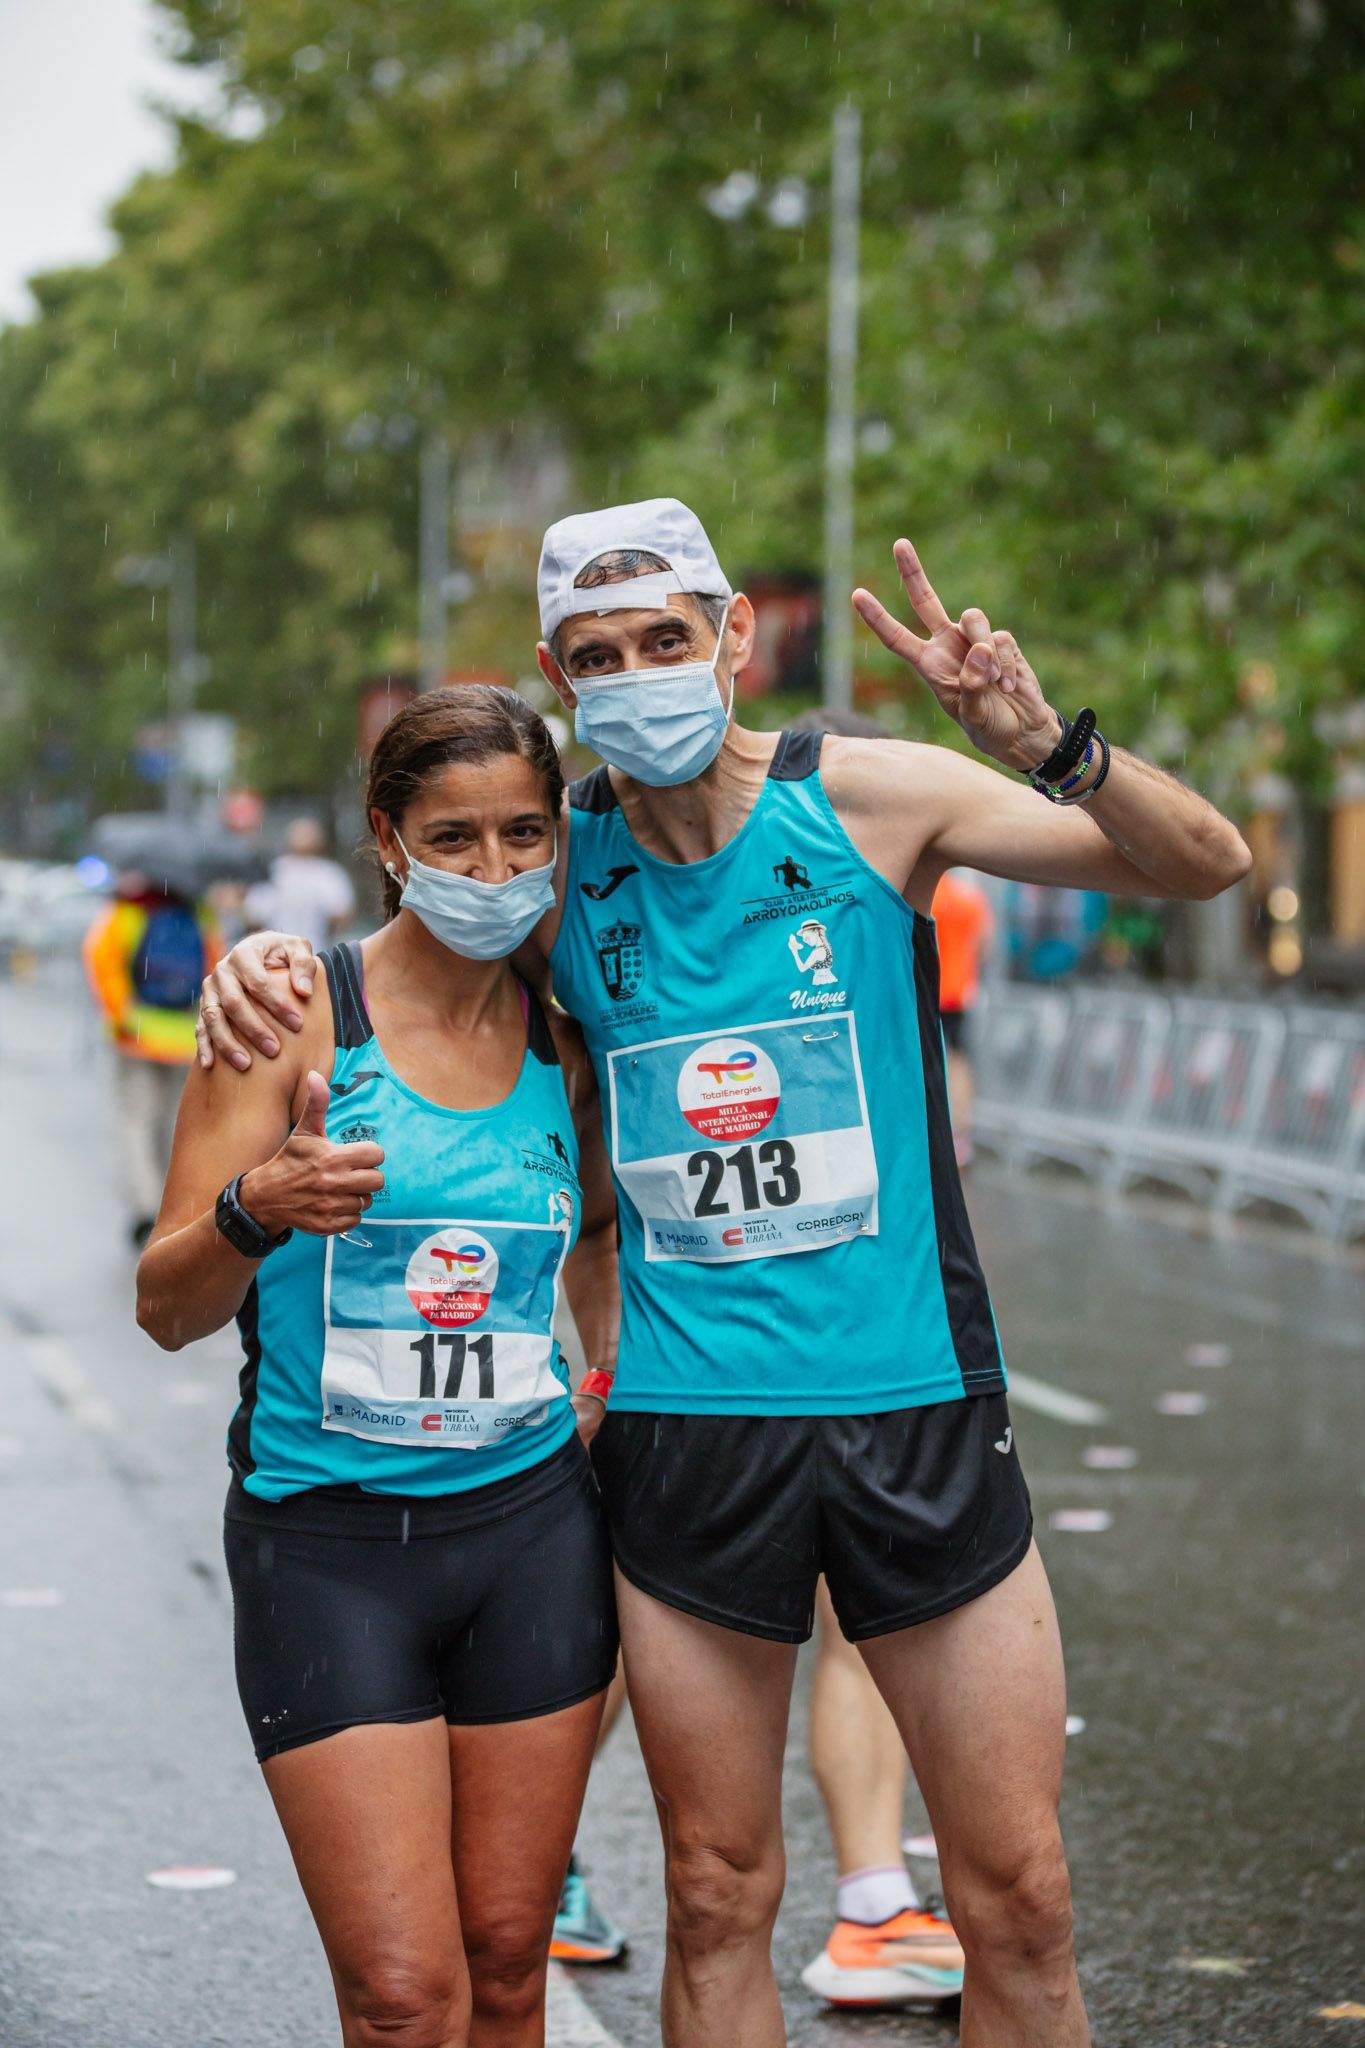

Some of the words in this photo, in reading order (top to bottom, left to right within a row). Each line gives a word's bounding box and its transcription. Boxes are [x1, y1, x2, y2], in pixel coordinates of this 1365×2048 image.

[764, 900, 784, 908] CLUB
[788, 890, 829, 904] ATLETISMO
[743, 890, 856, 925] ARROYOMOLINOS
[789, 990, 847, 1010] Unique
[701, 1086, 762, 1100] TotalEnergies
[718, 1105, 748, 1116] MILLA
[710, 1127, 724, 1136] DE
[725, 1121, 761, 1134] MADRID
[687, 1139, 801, 1218] 213
[744, 1224, 776, 1235] MILLA
[666, 1233, 708, 1246] MADRID
[745, 1231, 783, 1244] URBANA
[440, 1311, 475, 1319] MADRID
[409, 1333, 495, 1399] 171
[351, 1408, 406, 1426] MADRID
[444, 1414, 475, 1423] MILLA
[443, 1423, 480, 1432] URBANA
